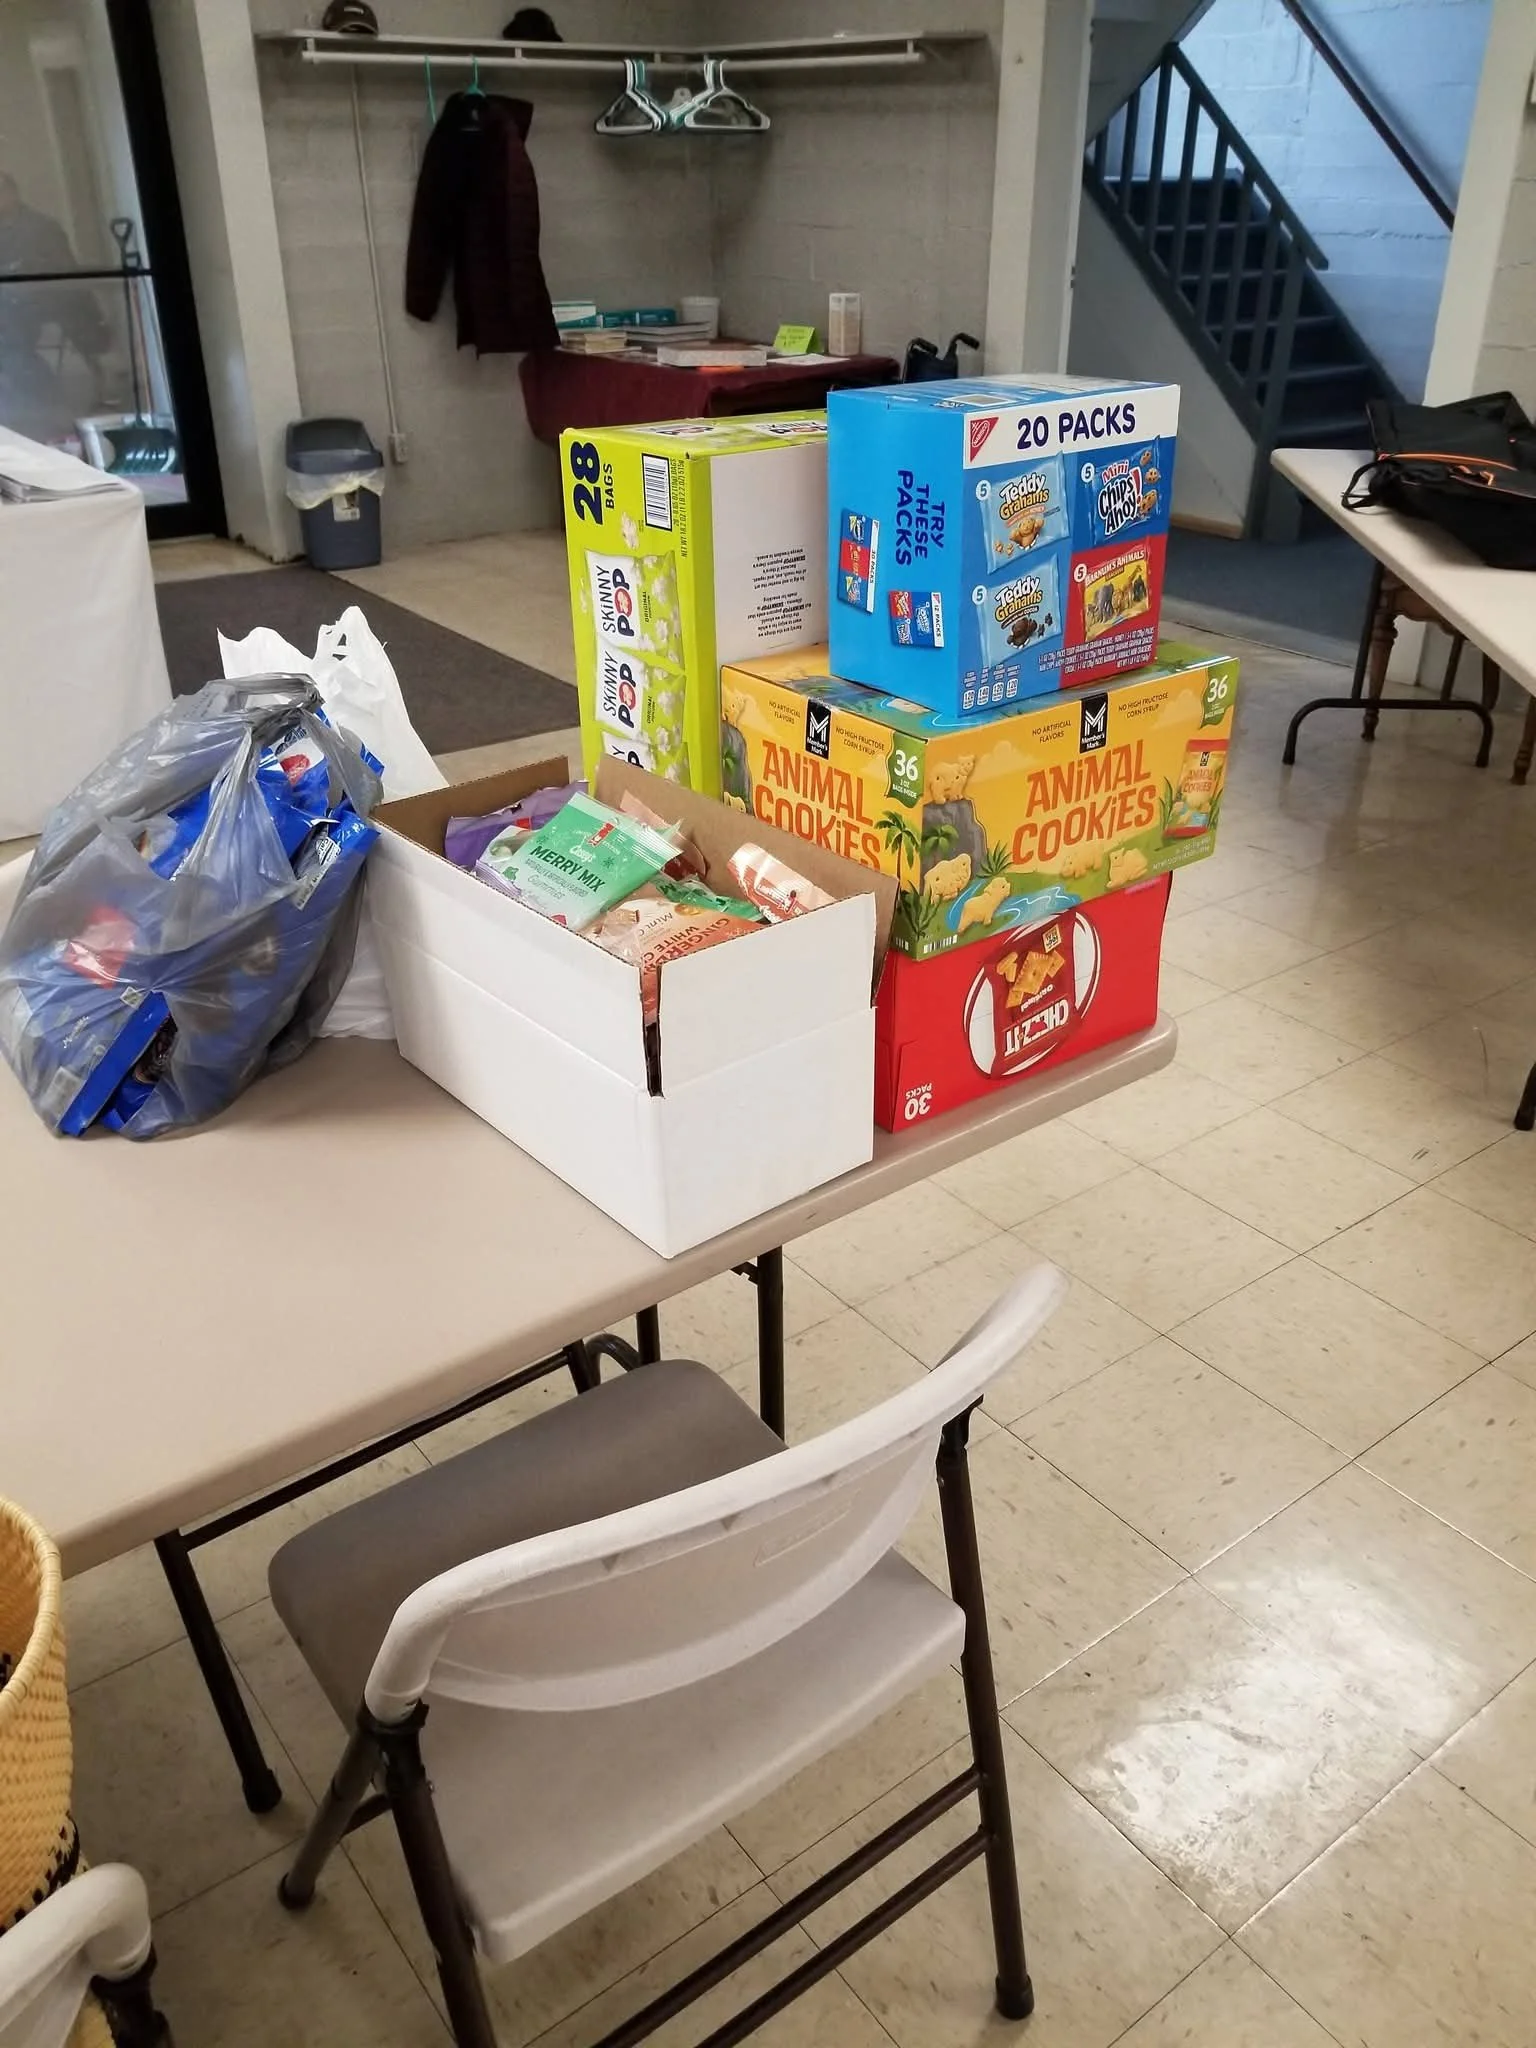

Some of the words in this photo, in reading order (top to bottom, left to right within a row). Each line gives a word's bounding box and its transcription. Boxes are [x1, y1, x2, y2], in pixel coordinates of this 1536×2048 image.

[1017, 416, 1049, 449] 20
[1058, 403, 1136, 444] PACKS
[570, 441, 603, 525] 28
[1102, 459, 1129, 484] Mini
[603, 463, 615, 509] BAGS
[999, 472, 1046, 504] Teddy
[1099, 477, 1134, 517] Chips
[895, 470, 913, 566] PACKS
[999, 489, 1050, 520] Grahams
[915, 484, 929, 559] THESE
[931, 501, 945, 548] TRY
[1116, 550, 1144, 568] ANIMALS
[612, 568, 635, 637] POP
[994, 576, 1040, 607] Teddy
[994, 590, 1043, 622] Grahams
[618, 662, 637, 729] POP
[1118, 703, 1128, 712] NO
[1128, 700, 1142, 710] HIGH
[1142, 692, 1169, 707] FRUCTOSE
[1207, 675, 1228, 703] 36
[769, 700, 777, 709] NO
[777, 703, 802, 719] ARTIFICIAL
[774, 711, 795, 725] FLAVORS
[1126, 708, 1142, 719] CORN
[1143, 704, 1160, 715] SYRUP
[835, 727, 844, 736] NO
[844, 730, 858, 740] HIGH
[858, 734, 885, 751] FRUCTOSE
[1032, 728, 1042, 736] NO
[1042, 719, 1072, 734] ARTIFICIAL
[1039, 730, 1065, 743] FLAVORS
[1081, 732, 1105, 745] Member's
[806, 736, 828, 751] Member's
[843, 739, 858, 750] CORN
[859, 744, 876, 756] SYRUP
[894, 750, 918, 781] 36
[530, 846, 583, 876] MERRY
[577, 869, 606, 893] MIX
[654, 926, 700, 953] WHITE
[906, 1082, 932, 1100] PACKS
[904, 1092, 932, 1120] 30
